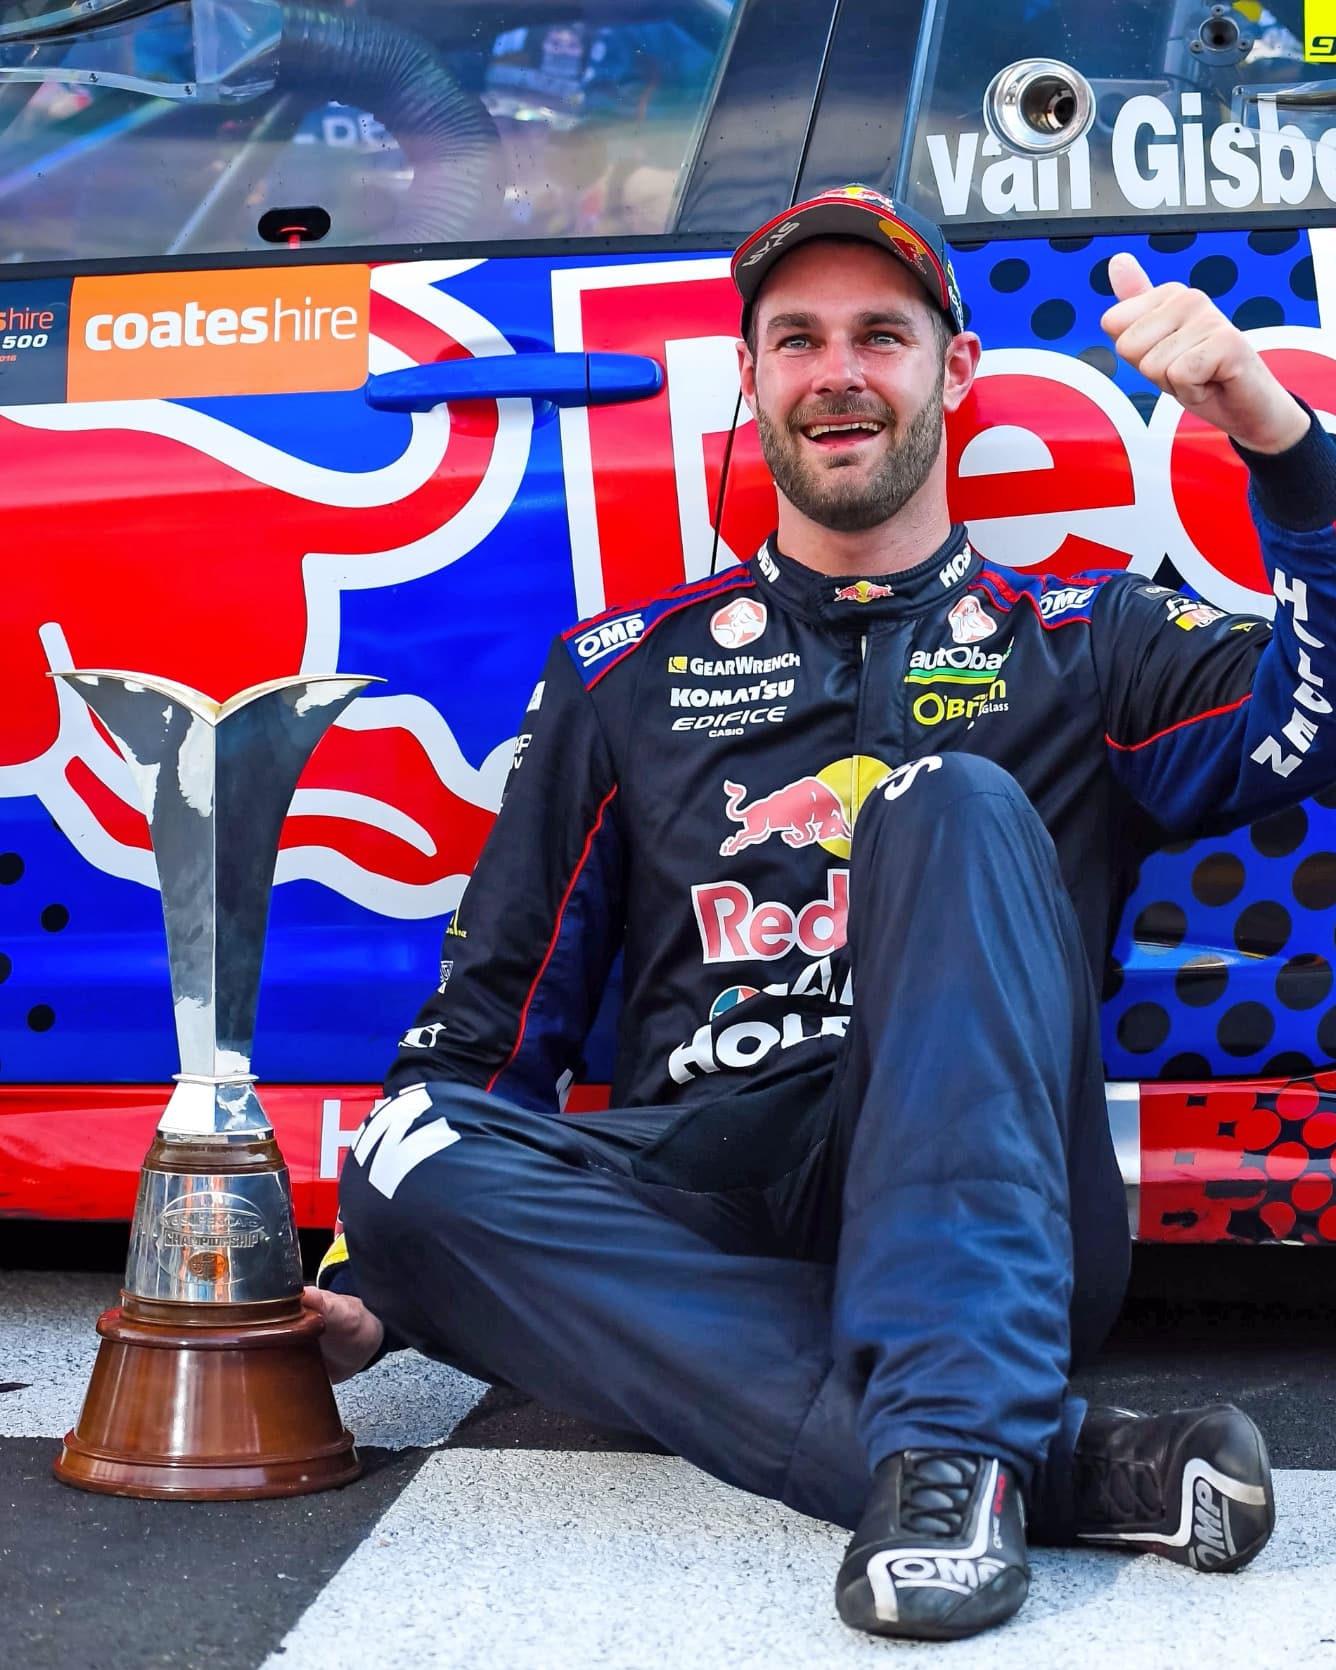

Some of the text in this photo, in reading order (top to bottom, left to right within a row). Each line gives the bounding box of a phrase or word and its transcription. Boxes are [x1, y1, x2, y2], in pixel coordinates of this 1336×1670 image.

[928, 120, 1092, 217] van
[2, 333, 49, 350] 500
[577, 616, 647, 659] OMP
[669, 678, 795, 708] KOMATSU
[671, 705, 788, 732] EDIFICE
[708, 727, 745, 738] CASIO
[691, 868, 851, 964] Red
